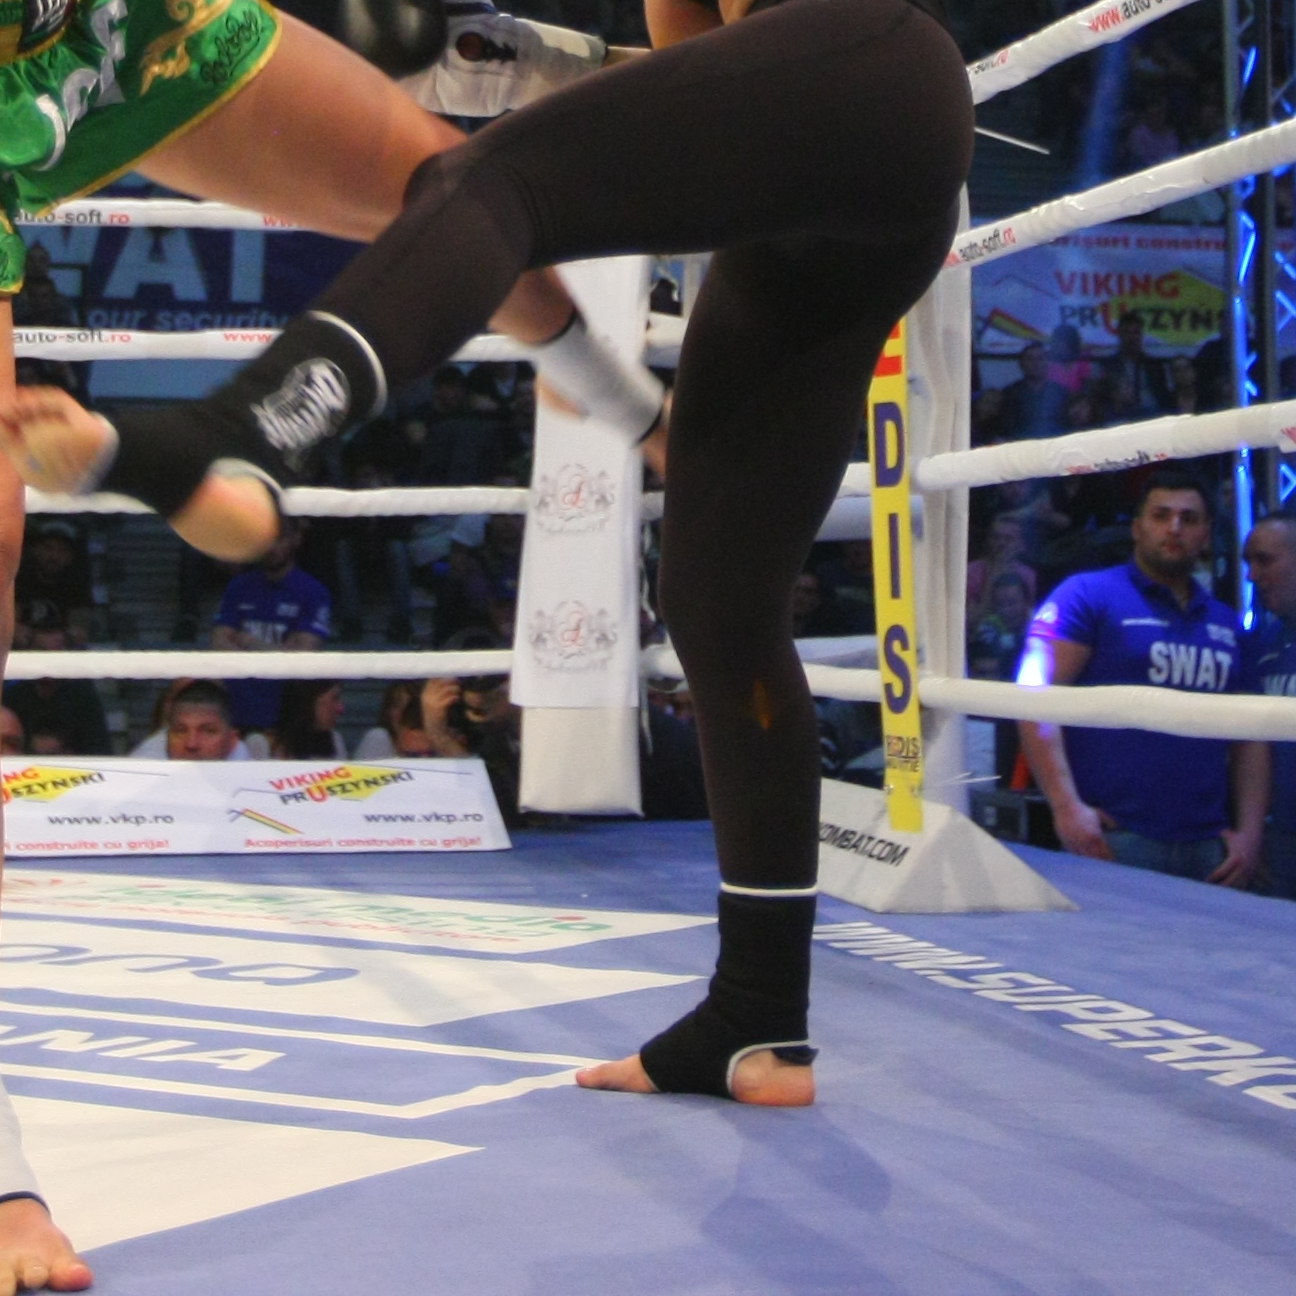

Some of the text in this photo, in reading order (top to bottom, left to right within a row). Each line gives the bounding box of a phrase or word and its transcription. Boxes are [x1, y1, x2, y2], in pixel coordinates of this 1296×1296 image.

[1055, 268, 1181, 299] VIKING
[1148, 640, 1233, 691] SWAT
[270, 765, 353, 791] VIKING
[280, 770, 415, 804] PRUSZYNSKI
[47, 812, 175, 827] www.vkp.ro
[364, 810, 484, 825] www.vkp.ro
[338, 837, 416, 850] construite
